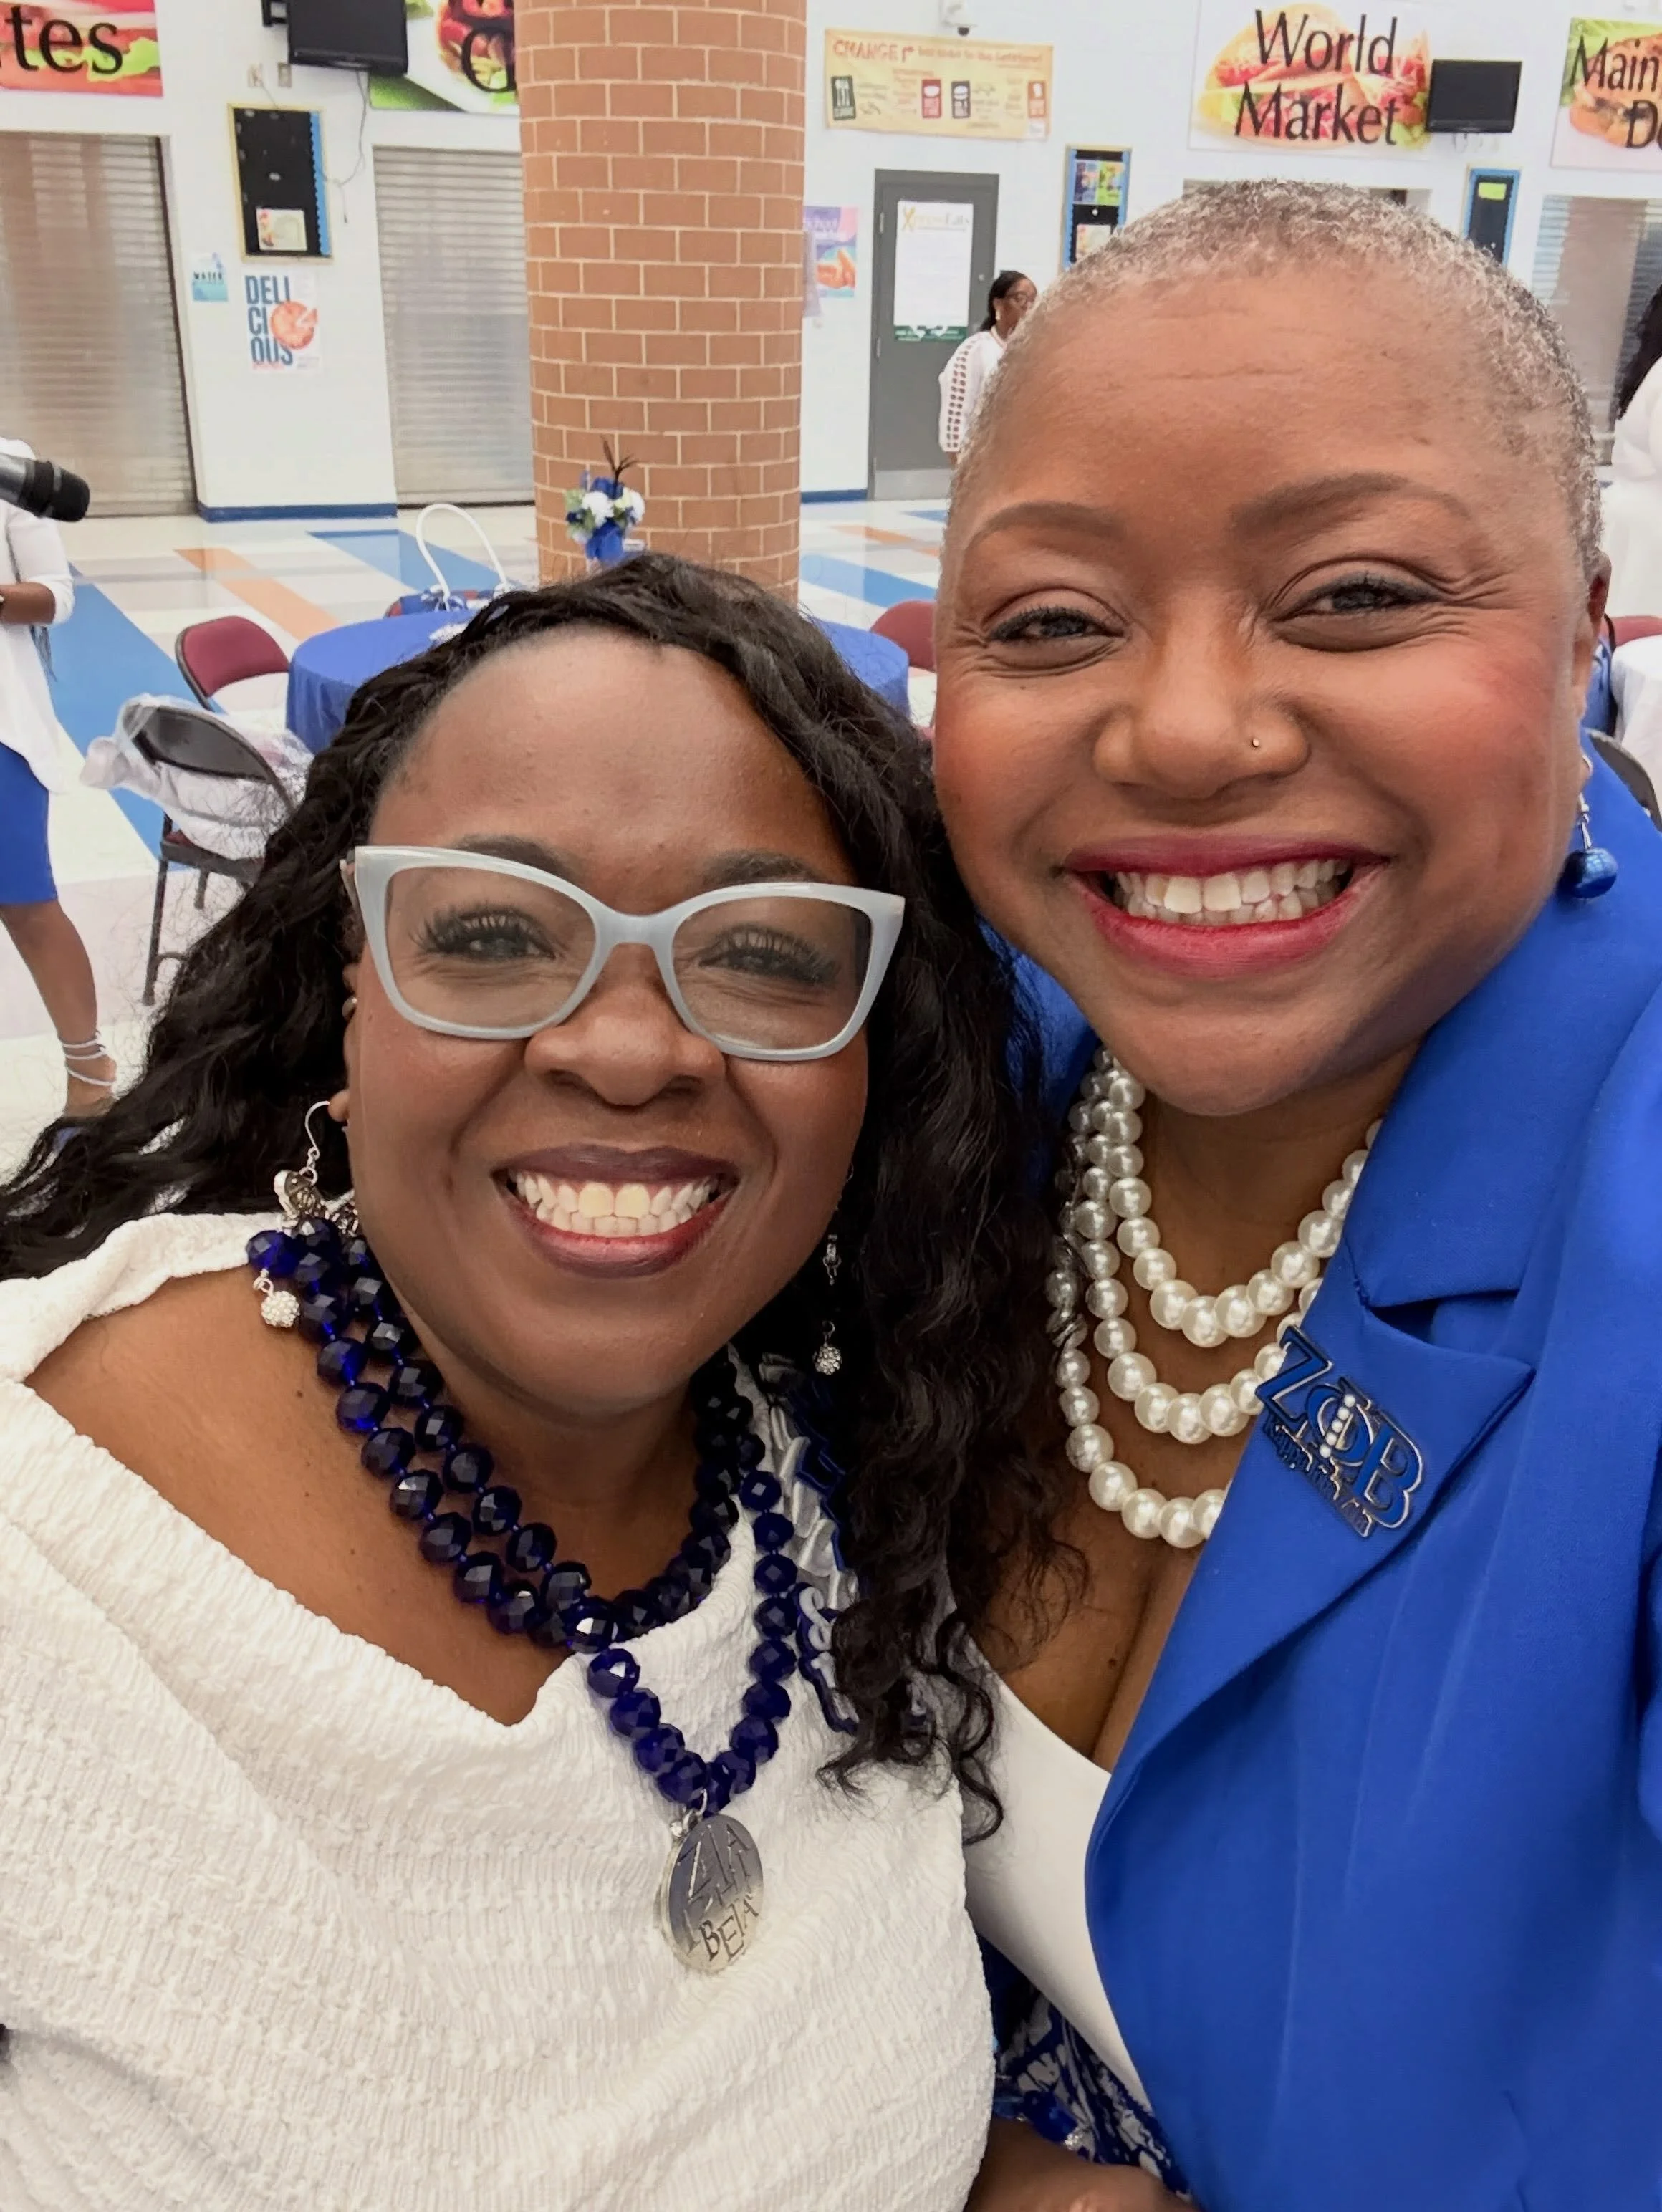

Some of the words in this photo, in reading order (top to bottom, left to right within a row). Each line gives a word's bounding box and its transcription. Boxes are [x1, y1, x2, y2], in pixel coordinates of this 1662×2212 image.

[0, 6, 123, 75] tes
[1254, 9, 1398, 74] World
[1568, 34, 1660, 92] Main
[1234, 81, 1398, 145] Market
[1625, 99, 1662, 150] D
[245, 275, 291, 305] DELI
